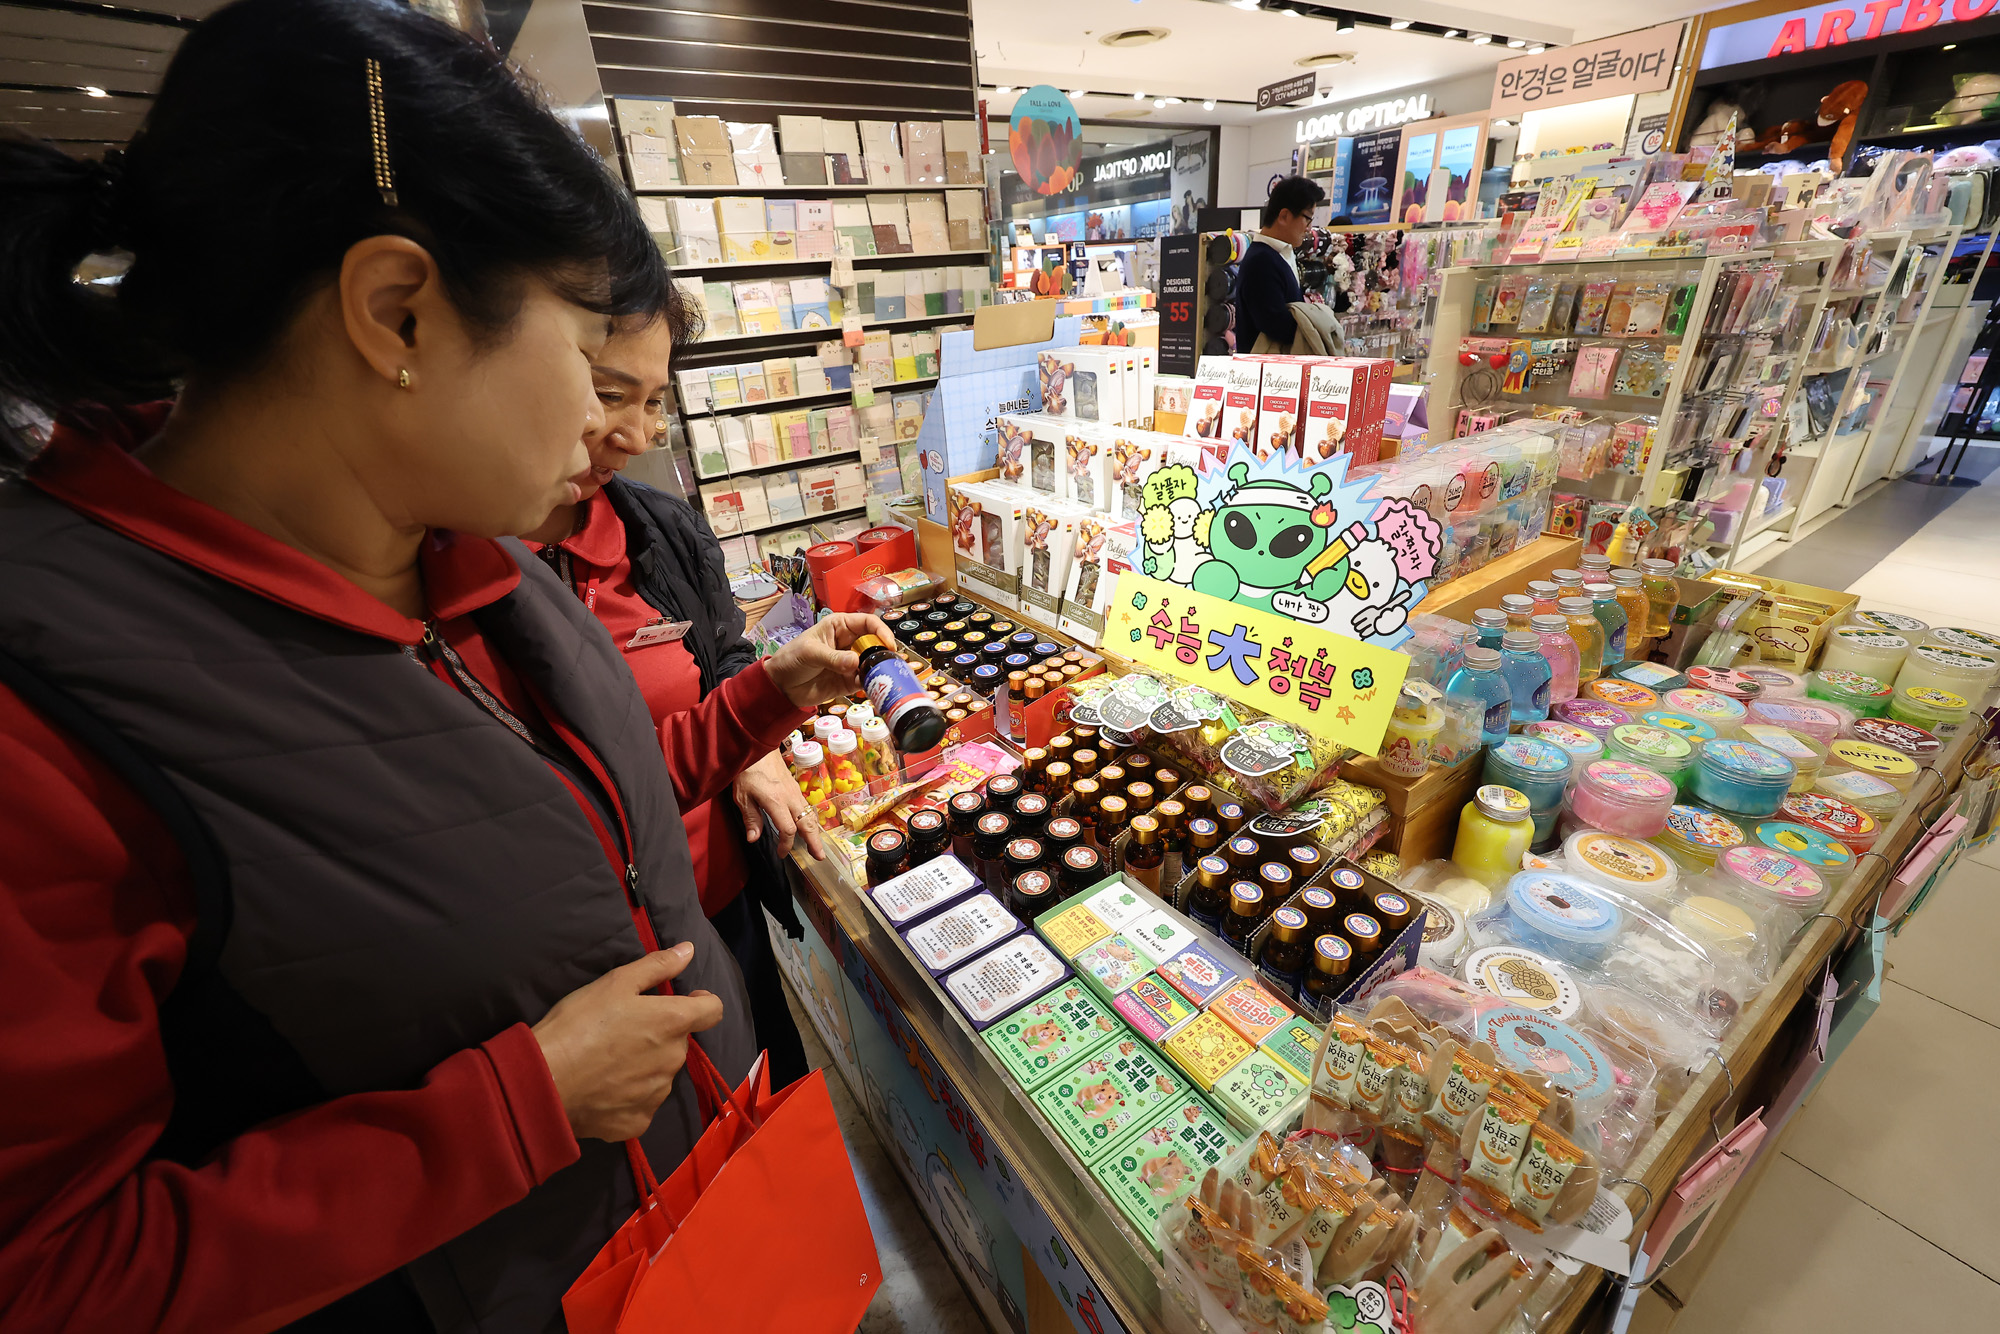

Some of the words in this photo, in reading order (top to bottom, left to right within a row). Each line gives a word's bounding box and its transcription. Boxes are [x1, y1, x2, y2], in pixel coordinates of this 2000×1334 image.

[1501, 64, 1567, 101] 안경은
[1572, 48, 1666, 90] 얼굴이다
[1296, 111, 1344, 143] LOOK
[1347, 93, 1431, 133] OPTICAL
[1166, 278, 1192, 286] DESIGNER
[1169, 302, 1189, 322] 55
[1198, 367, 1227, 381] Belgian
[1228, 373, 1258, 388] Belgian
[1263, 376, 1299, 394] Belgian
[1311, 380, 1349, 400] Belgian
[998, 399, 1030, 414] 늘어나는
[1317, 404, 1339, 412] CHOCOLATE
[1152, 477, 1187, 500] 잘풀자
[1391, 519, 1423, 572] 잘찍자
[1279, 597, 1302, 612] 내가
[1308, 602, 1321, 618] 짱
[1146, 607, 1202, 665] 수능
[1206, 623, 1262, 686] 大
[1268, 647, 1337, 712] 정복
[1839, 750, 1904, 763] BUTTER
[932, 868, 952, 887] 합격증서
[971, 908, 994, 930] 합격증서
[1136, 928, 1150, 942] Good
[1151, 940, 1166, 954] luck!
[1014, 951, 1040, 976] 합격증서
[1184, 956, 1214, 982] 부터스
[1138, 982, 1172, 1010] 합격
[1059, 1001, 1085, 1032] 합격햄
[1074, 998, 1096, 1019] 절대
[1524, 1016, 1559, 1032] slime
[1328, 1042, 1358, 1064] 호박엿
[1114, 1058, 1150, 1094] 합격햄
[1131, 1055, 1157, 1079] 절대
[1231, 1080, 1270, 1117] 합격기원
[1447, 1074, 1480, 1103] 호박엿
[1198, 1120, 1228, 1150] 절대
[1484, 1119, 1521, 1147] 호박엿
[1178, 1126, 1222, 1166] 합격햄
[1528, 1153, 1566, 1185] 호박엿
[1264, 1188, 1290, 1222] 호박엿
[1359, 1299, 1376, 1314] 있다
